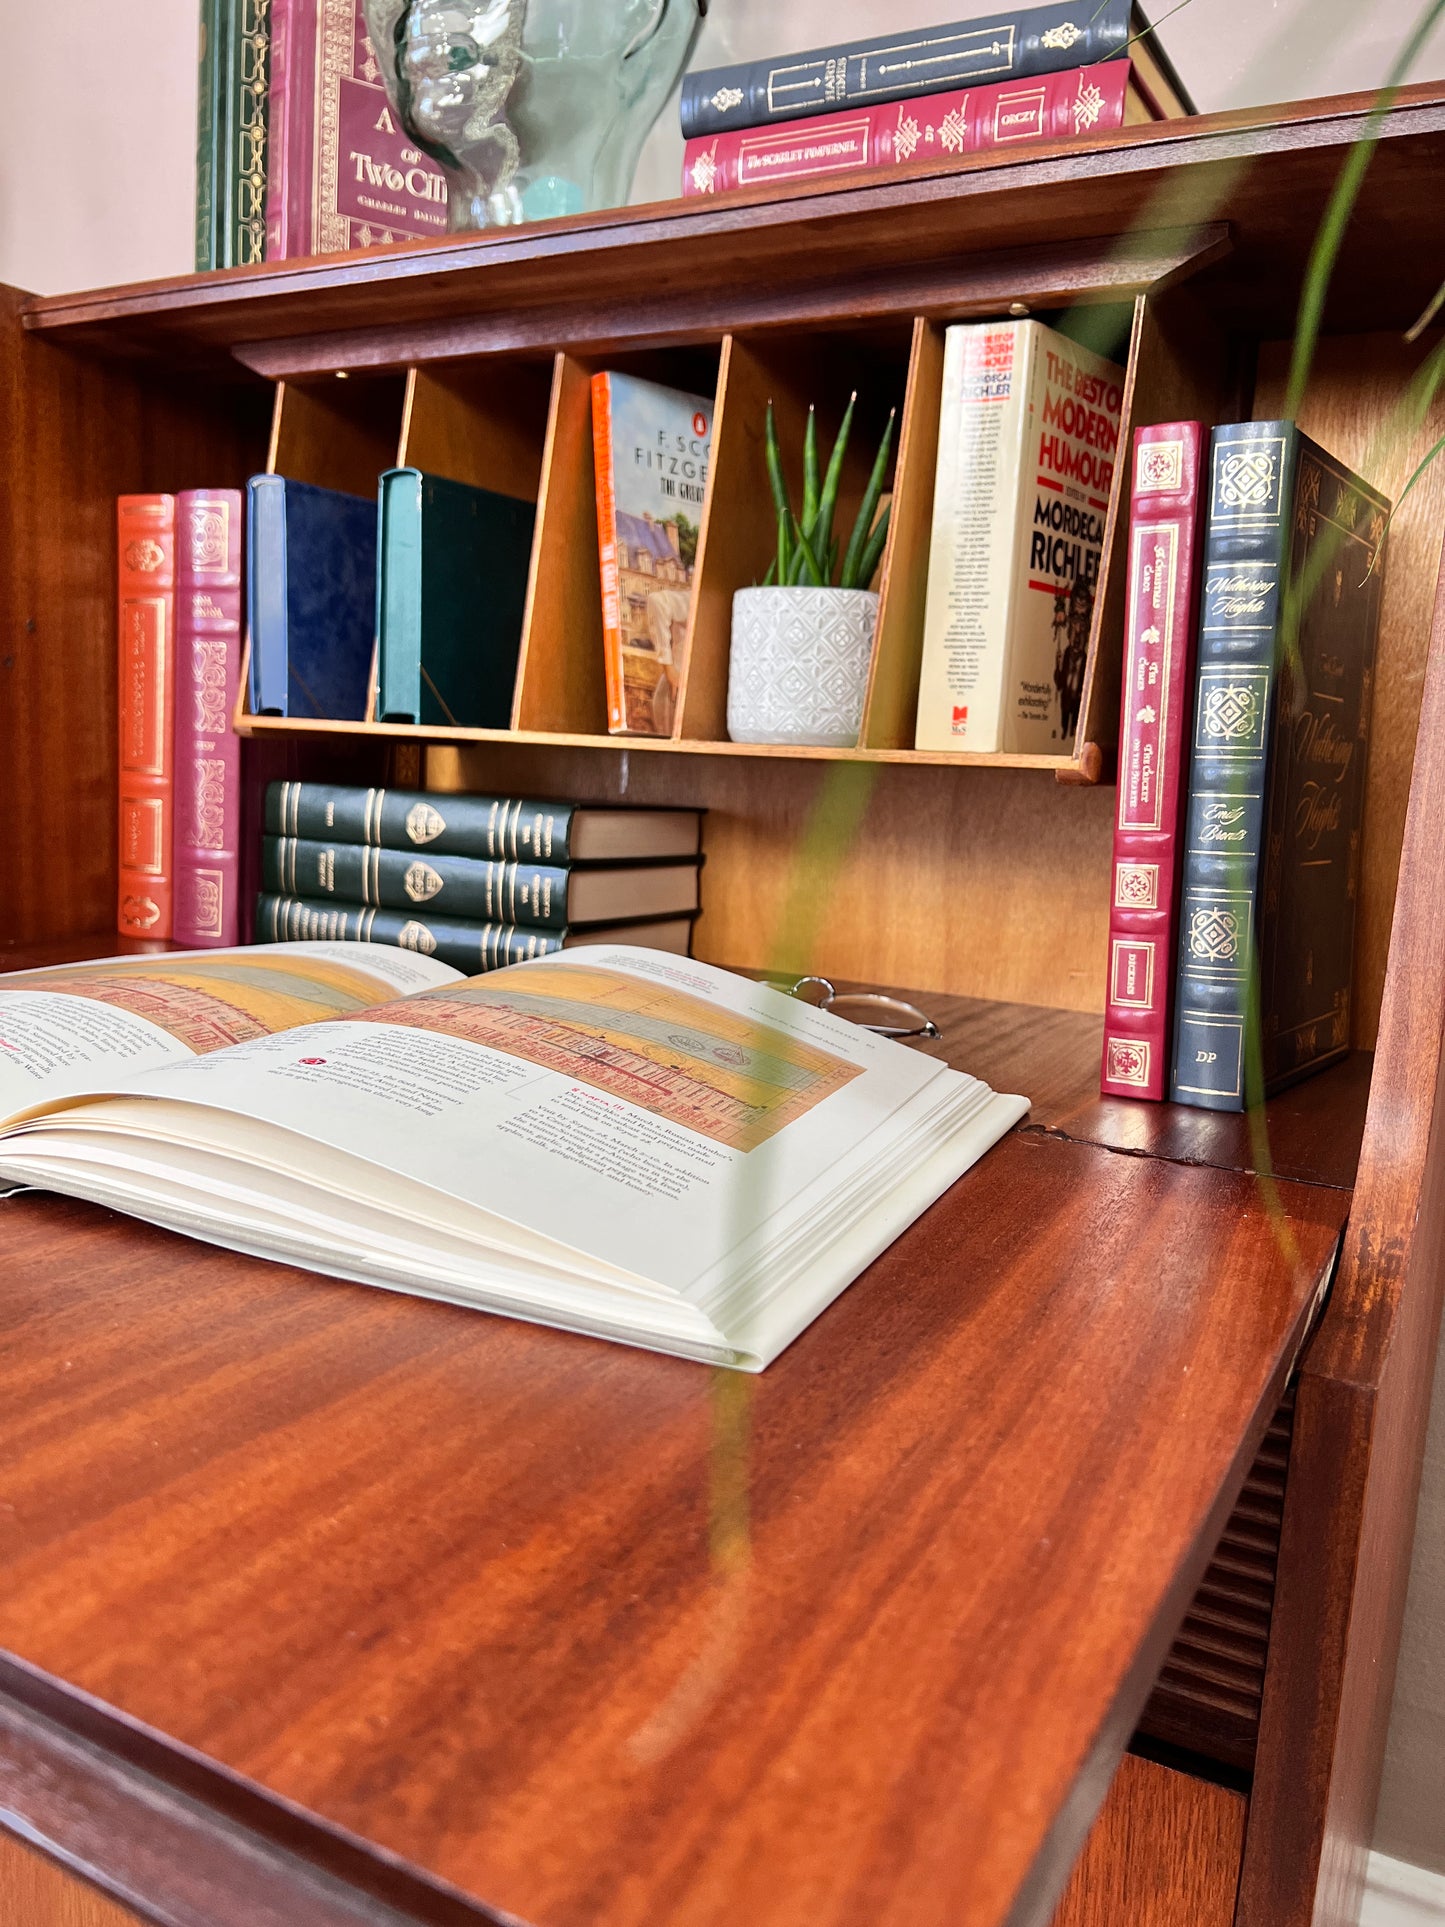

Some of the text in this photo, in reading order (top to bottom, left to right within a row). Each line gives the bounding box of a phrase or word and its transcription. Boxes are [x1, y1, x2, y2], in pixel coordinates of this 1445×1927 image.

[824, 59, 836, 102] HARD
[373, 107, 396, 135] A
[1001, 110, 1037, 126] ORCZY
[400, 148, 422, 165] OF
[763, 149, 804, 167] SCARLET
[1046, 351, 1073, 393] THE
[1074, 366, 1107, 409] BEST
[635, 447, 709, 484] FITZGE
[1039, 433, 1115, 495] HUMOUR
[661, 477, 675, 497] THE
[1034, 496, 1105, 546] MORDECA
[1206, 575, 1275, 597] Wuthering
[1208, 597, 1264, 618] Heights
[1203, 803, 1245, 825] Emily
[1126, 953, 1137, 995] DICKENS
[1196, 1051, 1216, 1063] DP
[585, 1100, 621, 1117] Grechko
[637, 1123, 688, 1147] Romanenko
[687, 1145, 712, 1158] made
[602, 1114, 642, 1133] broadcast
[657, 1138, 695, 1157] prepared
[695, 1155, 716, 1166] mail
[628, 1112, 655, 1126] March
[664, 1128, 696, 1144] Russian
[558, 1135, 596, 1154] brought
[601, 1155, 639, 1173] package
[637, 1171, 662, 1183] with
[659, 1181, 682, 1193] fresh
[611, 1137, 640, 1152] March
[675, 1166, 710, 1183] addition
[618, 1148, 644, 1161] (who
[642, 1159, 677, 1176] became
